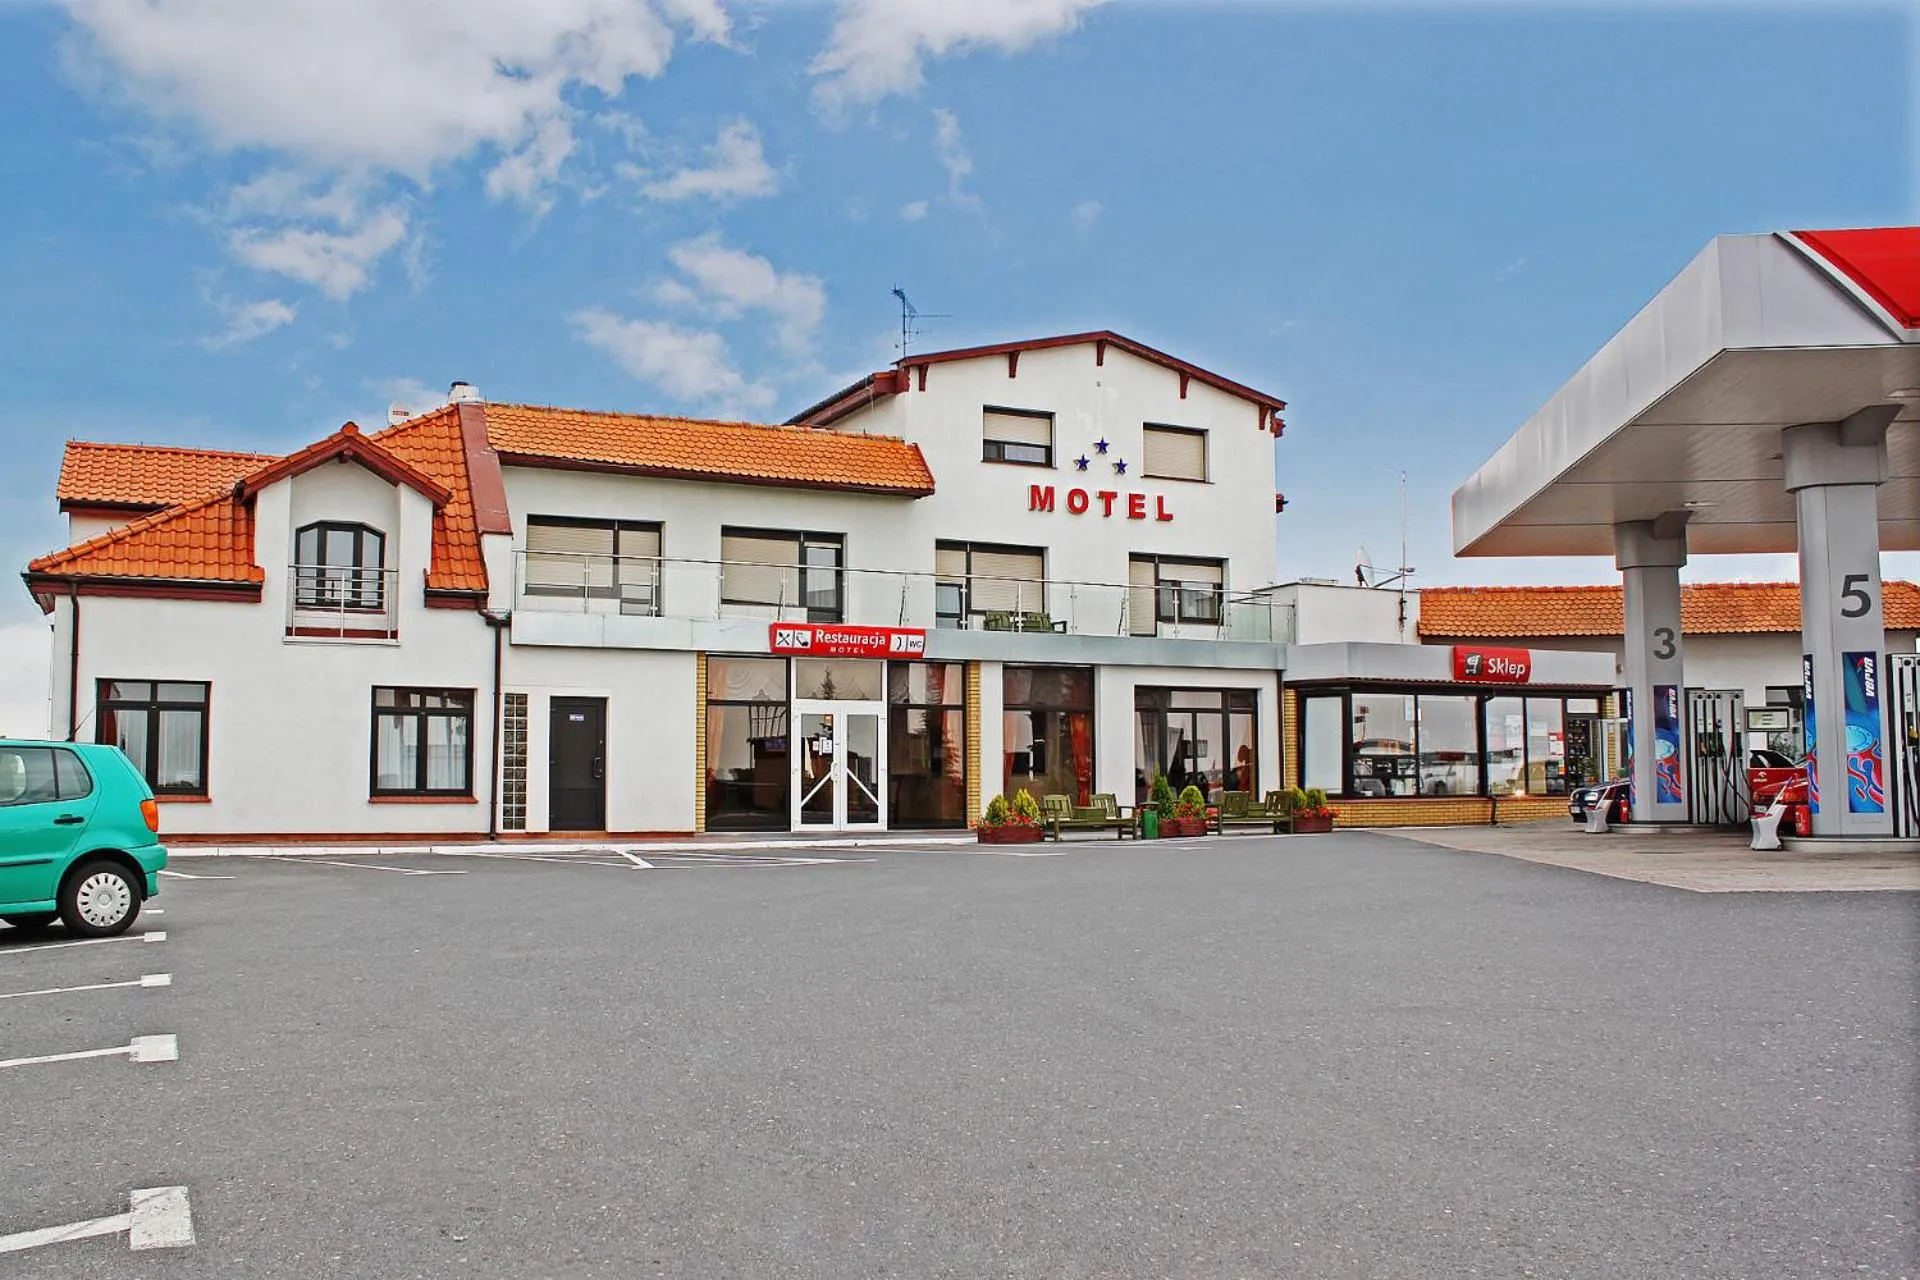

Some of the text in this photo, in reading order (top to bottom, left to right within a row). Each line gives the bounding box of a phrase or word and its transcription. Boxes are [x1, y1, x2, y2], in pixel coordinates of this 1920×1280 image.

[1029, 485, 1174, 521] MOTEL
[1841, 574, 1871, 618] 5
[815, 629, 886, 649] Restauracja
[830, 646, 865, 654] MOTEL
[909, 639, 922, 649] WC
[1653, 627, 1676, 660] 3
[1487, 657, 1526, 679] Sklep
